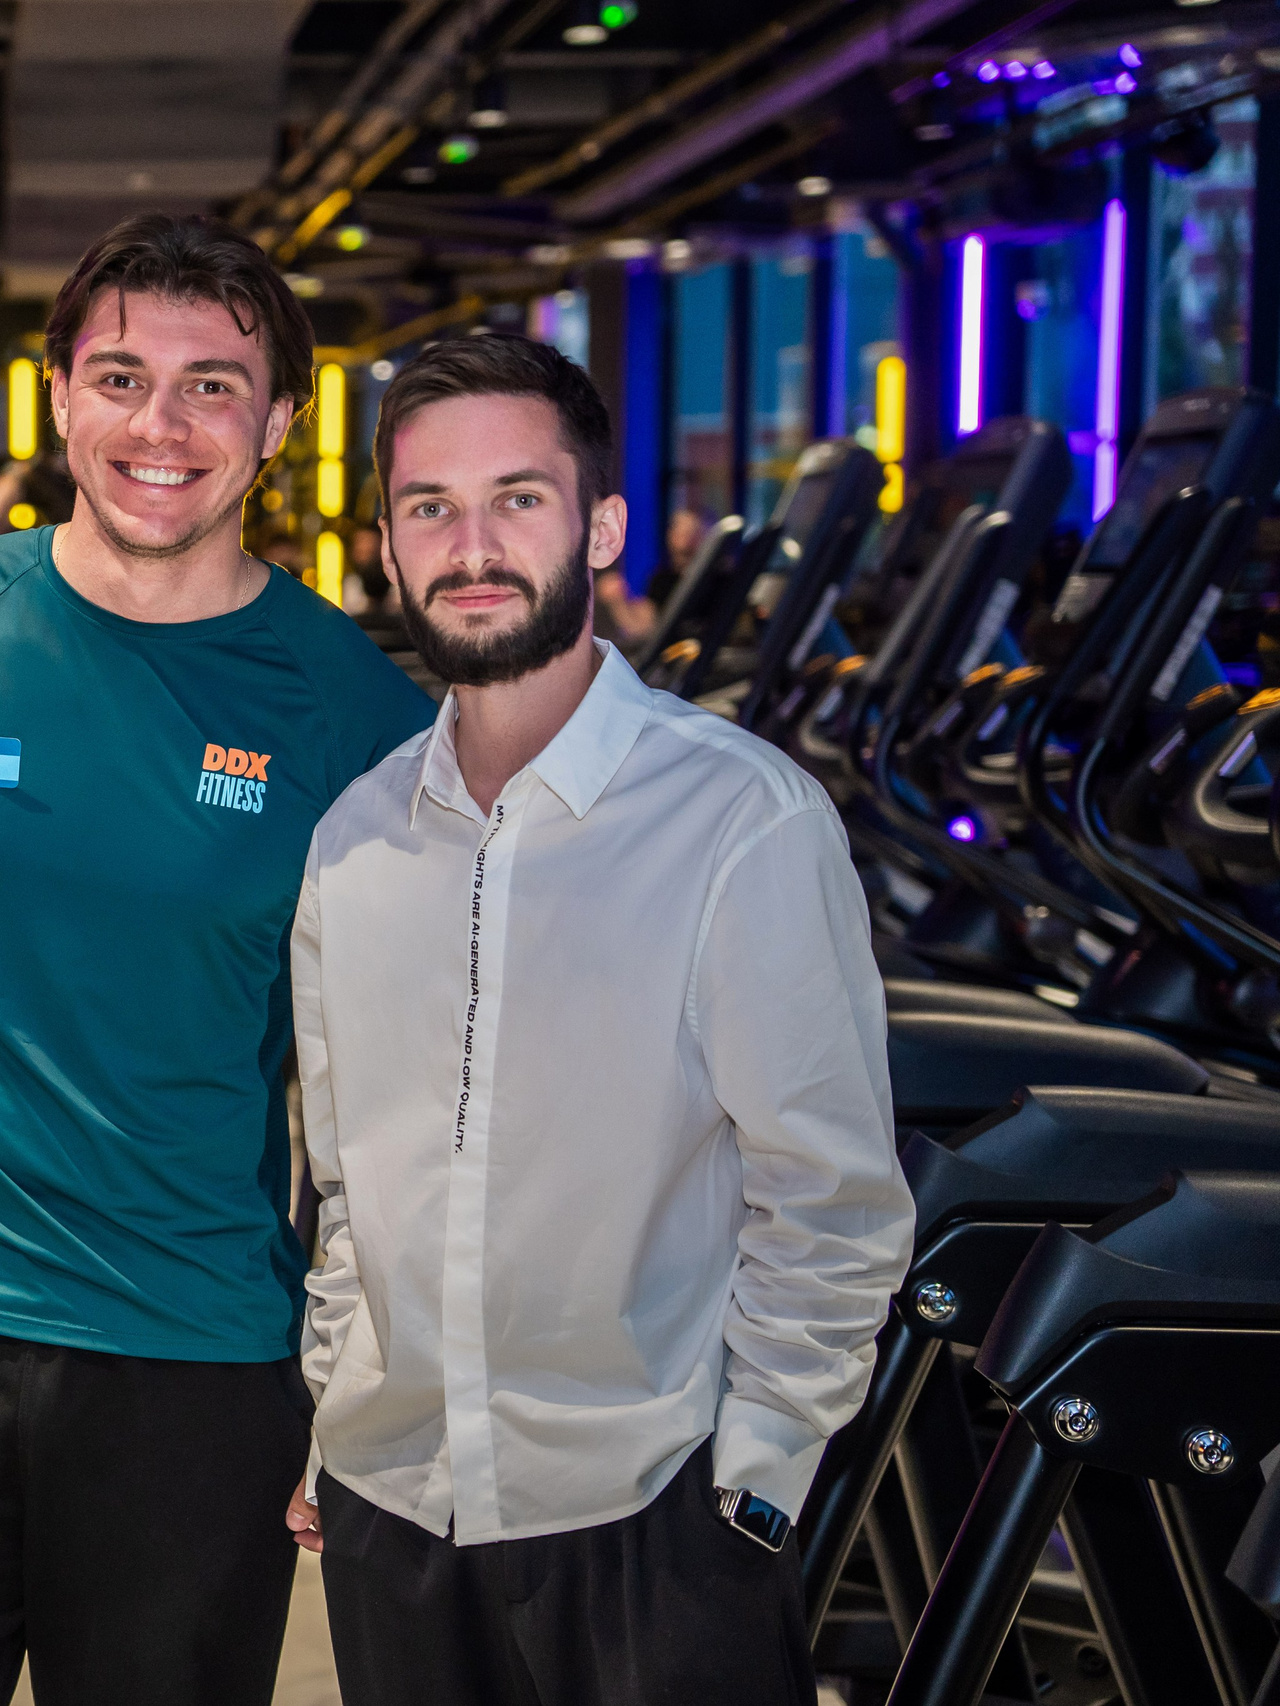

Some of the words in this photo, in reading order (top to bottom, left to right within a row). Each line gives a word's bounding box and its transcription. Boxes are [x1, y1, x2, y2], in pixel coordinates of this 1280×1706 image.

[202, 743, 272, 782] DDX
[196, 771, 266, 814] FITNESS
[496, 804, 504, 824] MY
[474, 826, 500, 889] TGHTS
[472, 891, 481, 920] ARE
[467, 921, 480, 1022] AI-GENERATED
[465, 1024, 474, 1055] AND
[462, 1057, 471, 1090] LOW
[455, 1092, 469, 1153] QUALITY.
